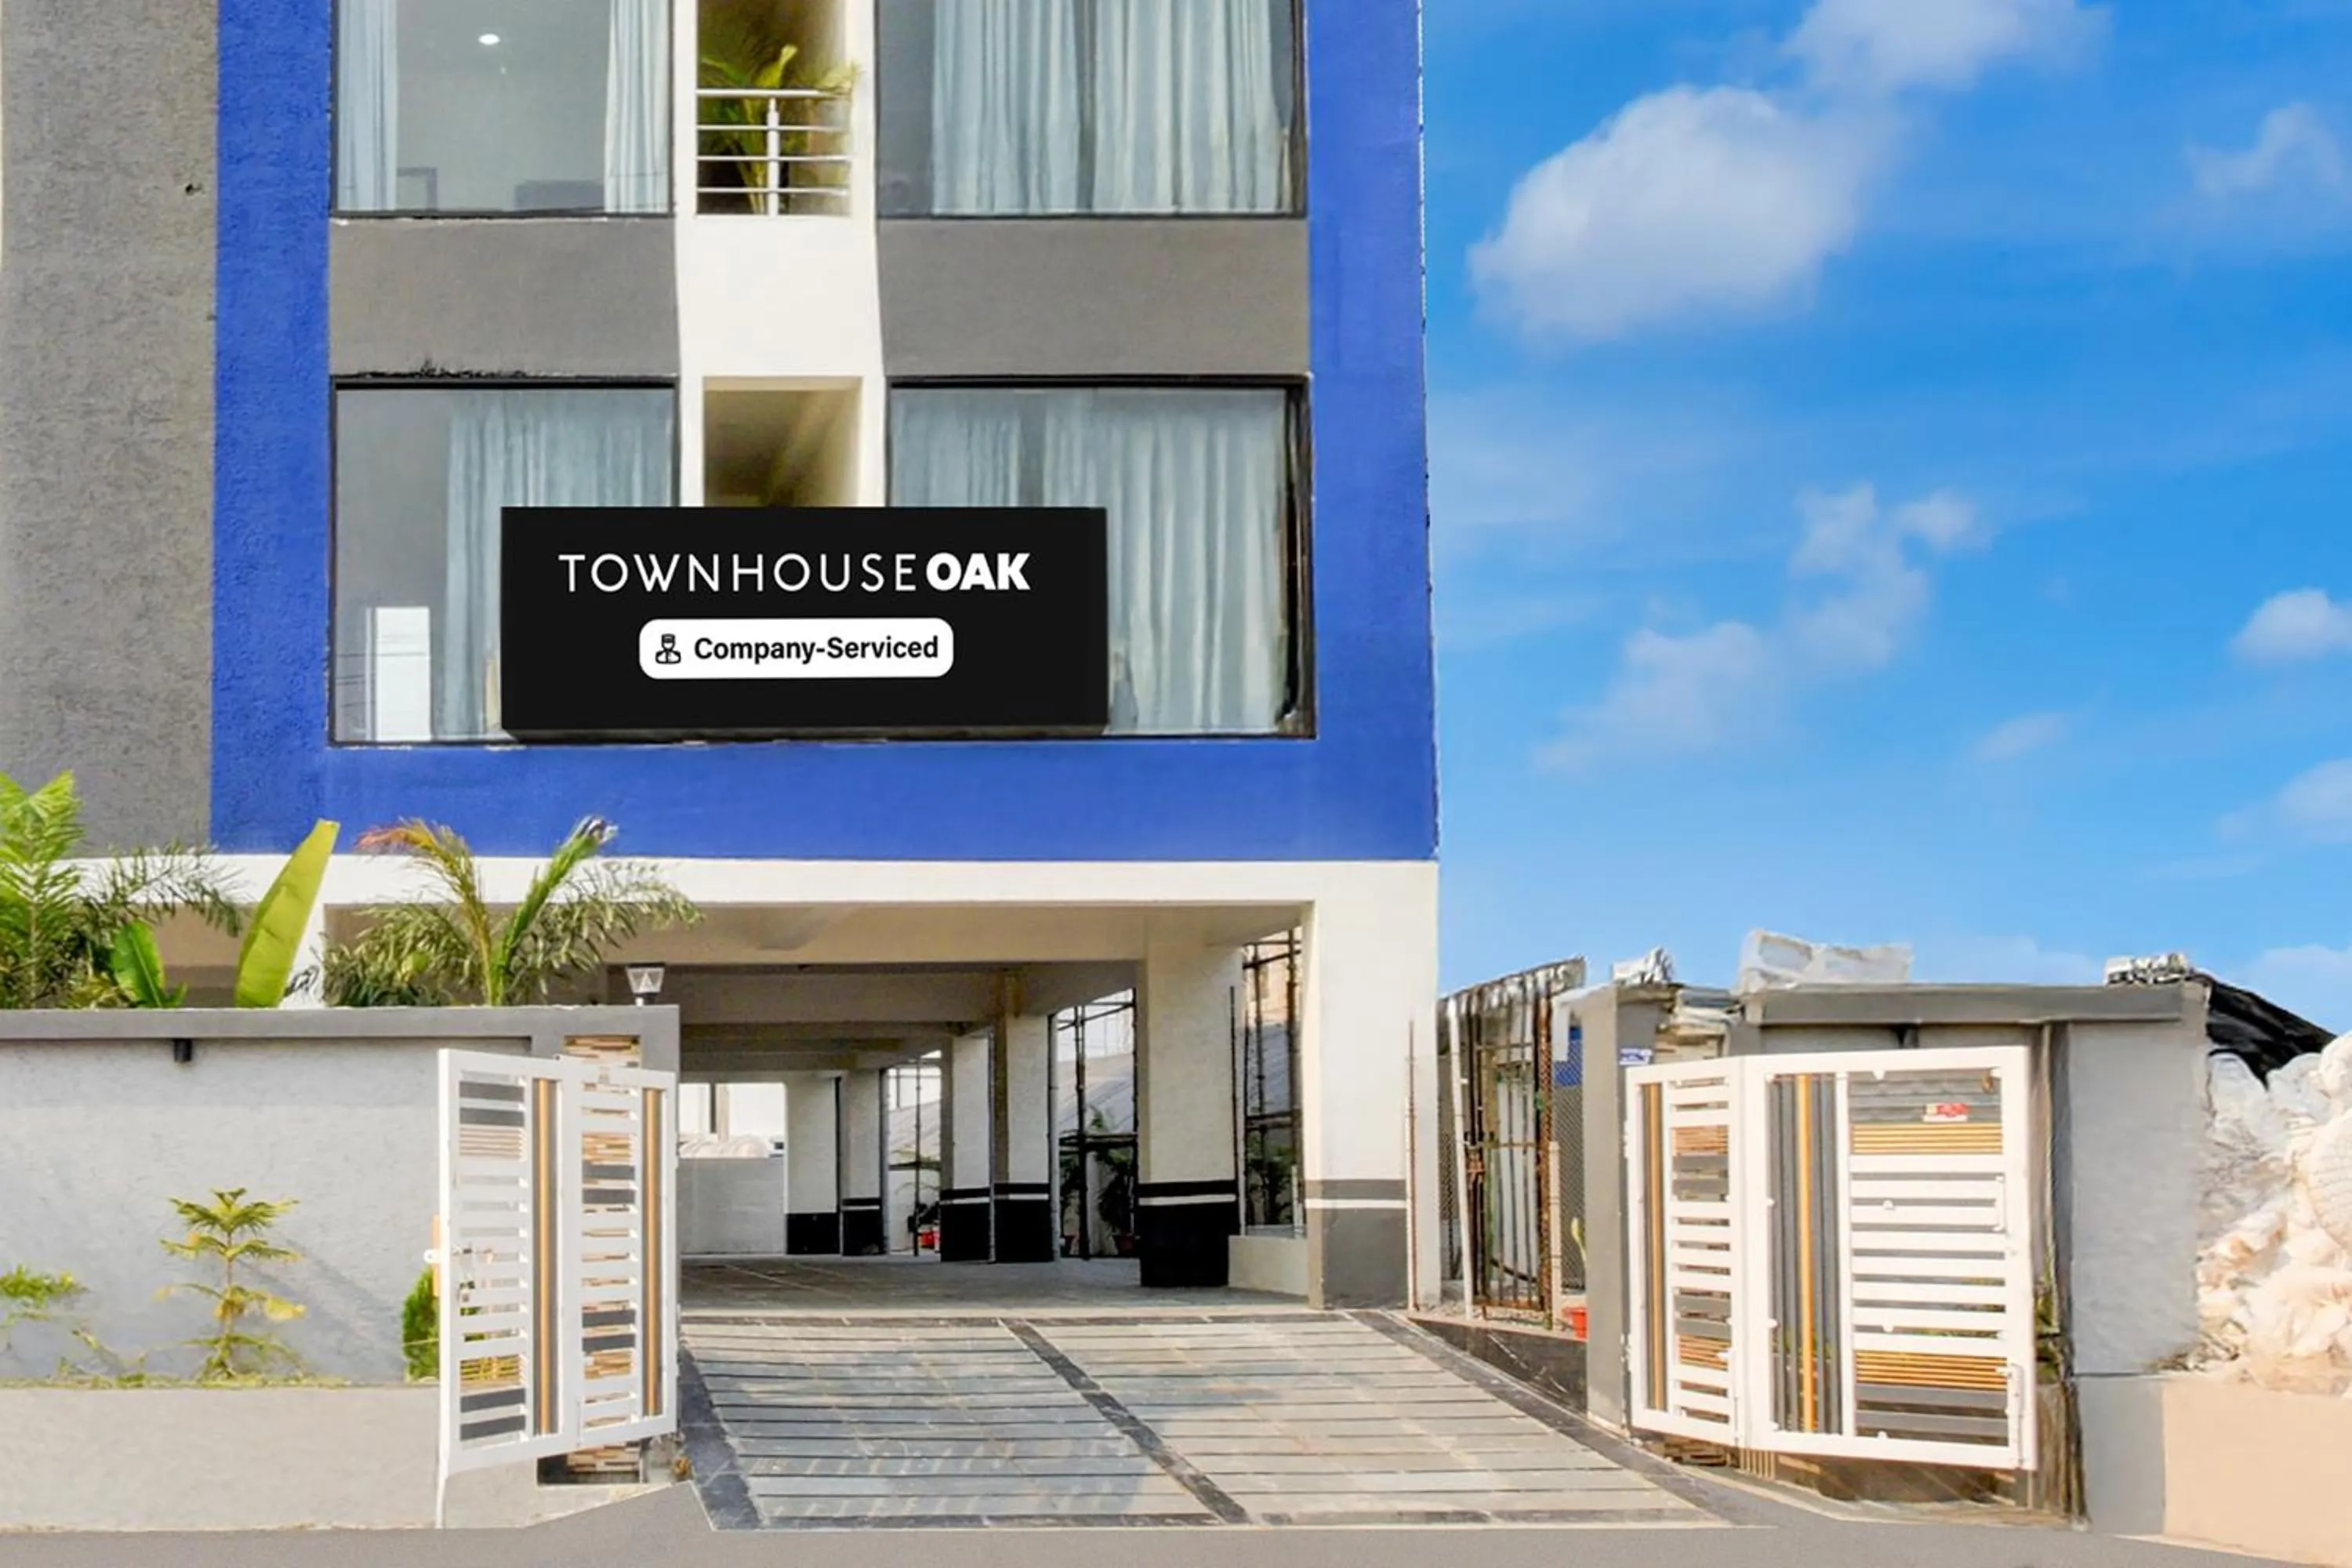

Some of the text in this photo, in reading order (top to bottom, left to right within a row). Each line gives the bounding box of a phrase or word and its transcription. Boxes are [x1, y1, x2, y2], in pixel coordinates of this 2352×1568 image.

[557, 552, 1031, 592] TOWNHOUSE OAK
[694, 635, 938, 665] Company-Serviced
